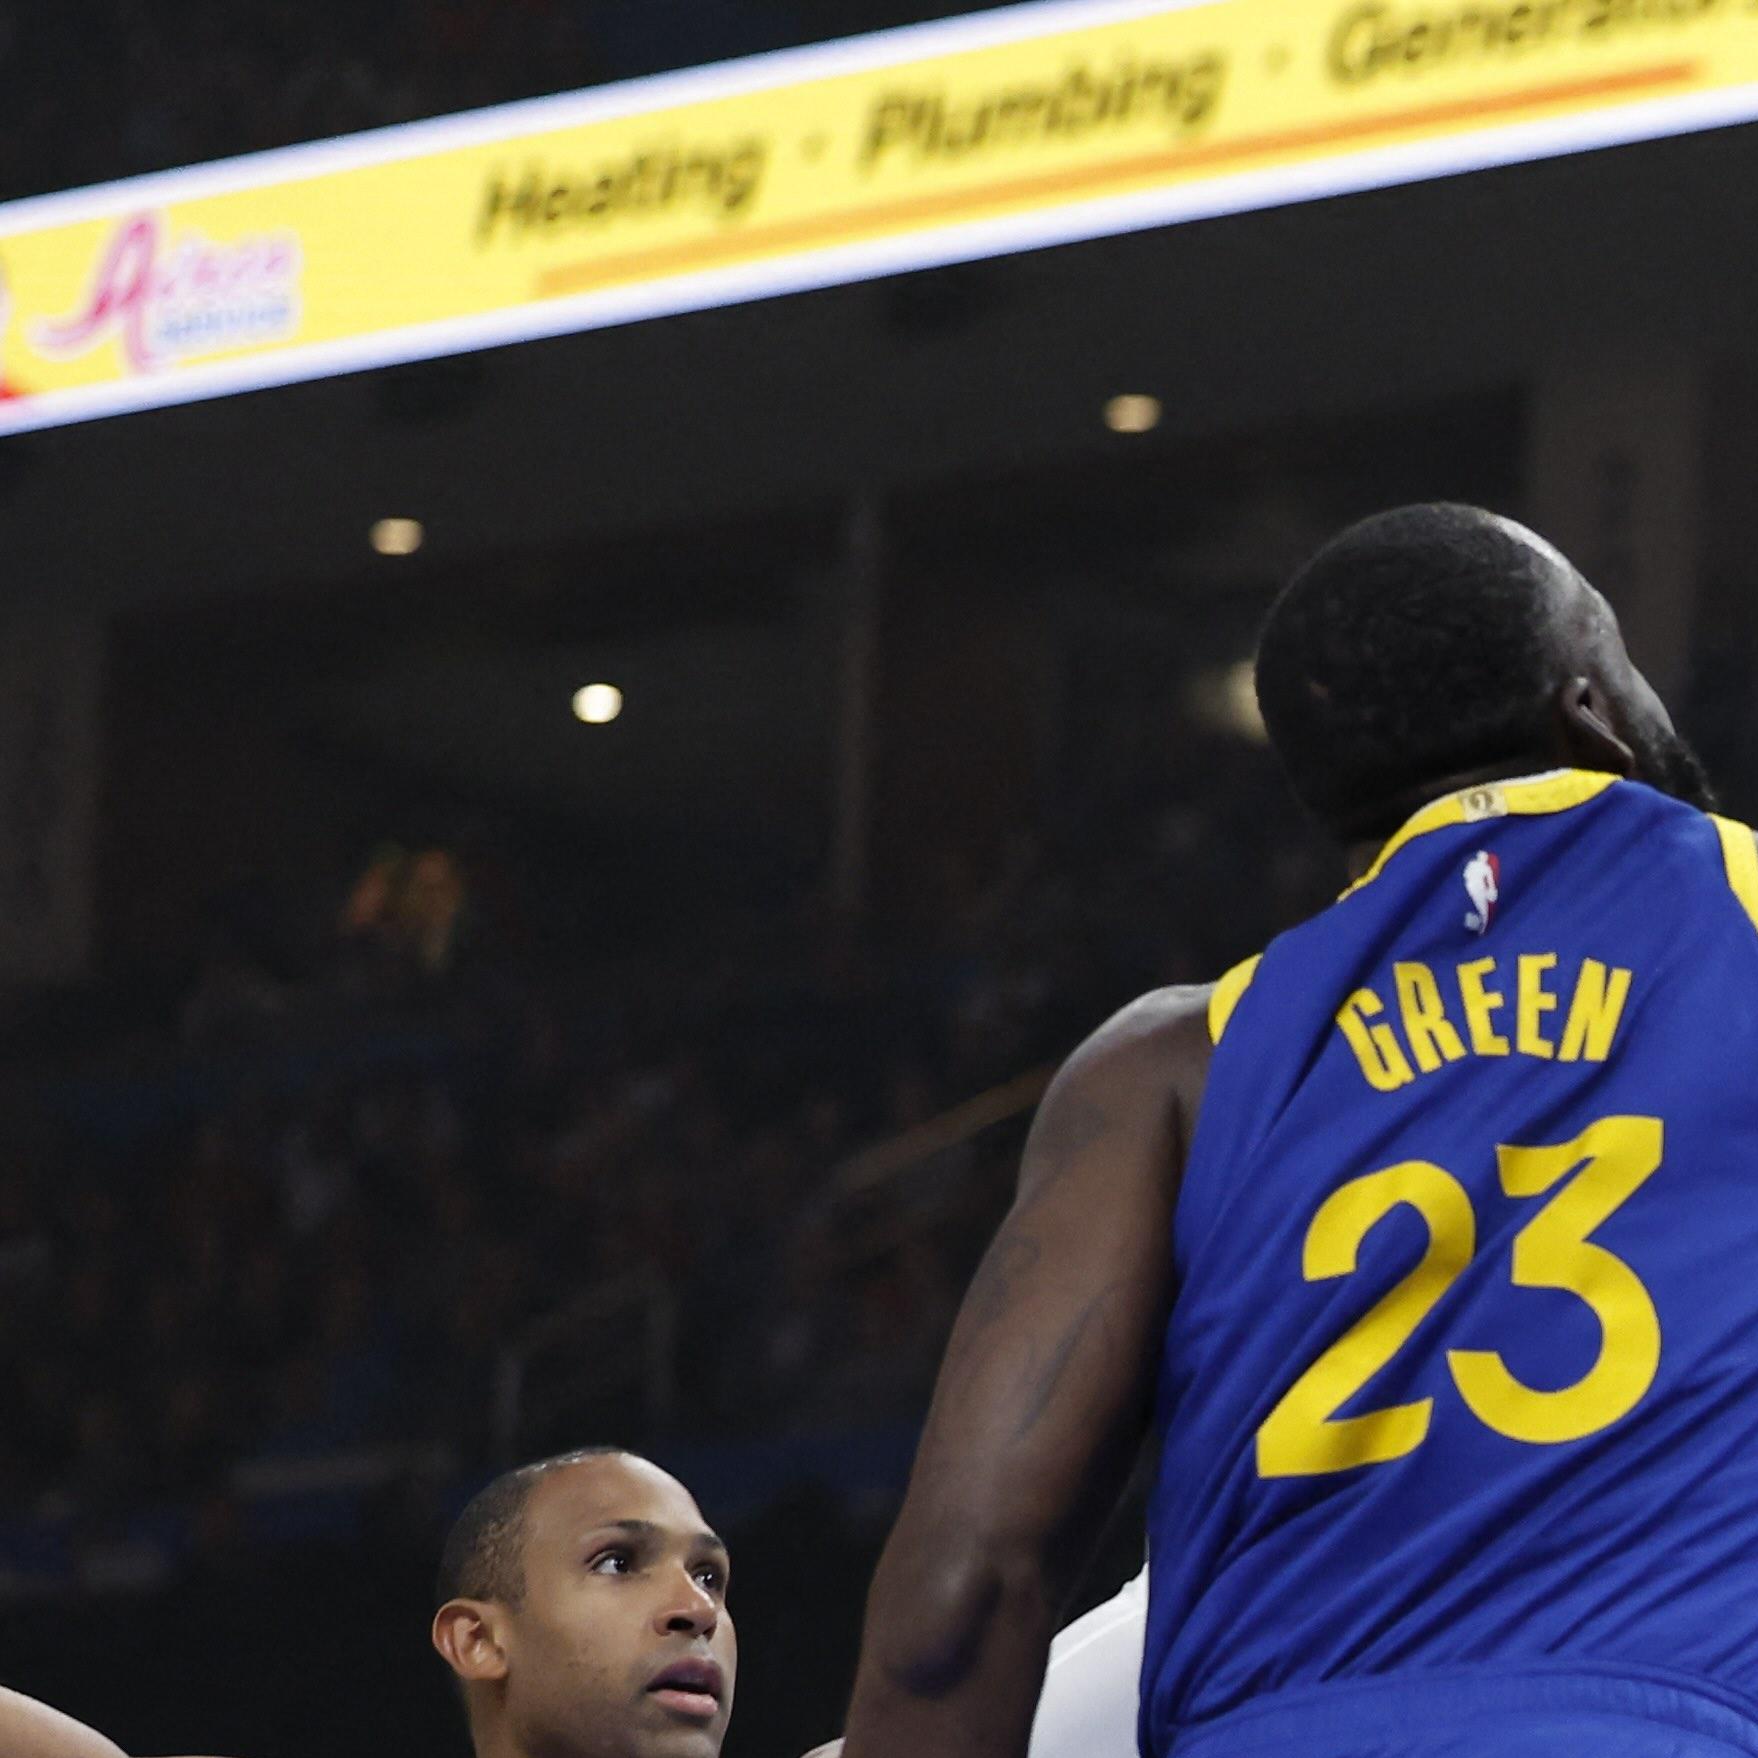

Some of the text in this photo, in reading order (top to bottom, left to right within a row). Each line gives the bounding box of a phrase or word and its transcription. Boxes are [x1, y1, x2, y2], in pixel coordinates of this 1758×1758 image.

[474, 136, 766, 246] Heating
[858, 50, 1226, 175] Plumbing
[1337, 952, 1632, 1092] GREEN
[1256, 1115, 1665, 1478] 23
